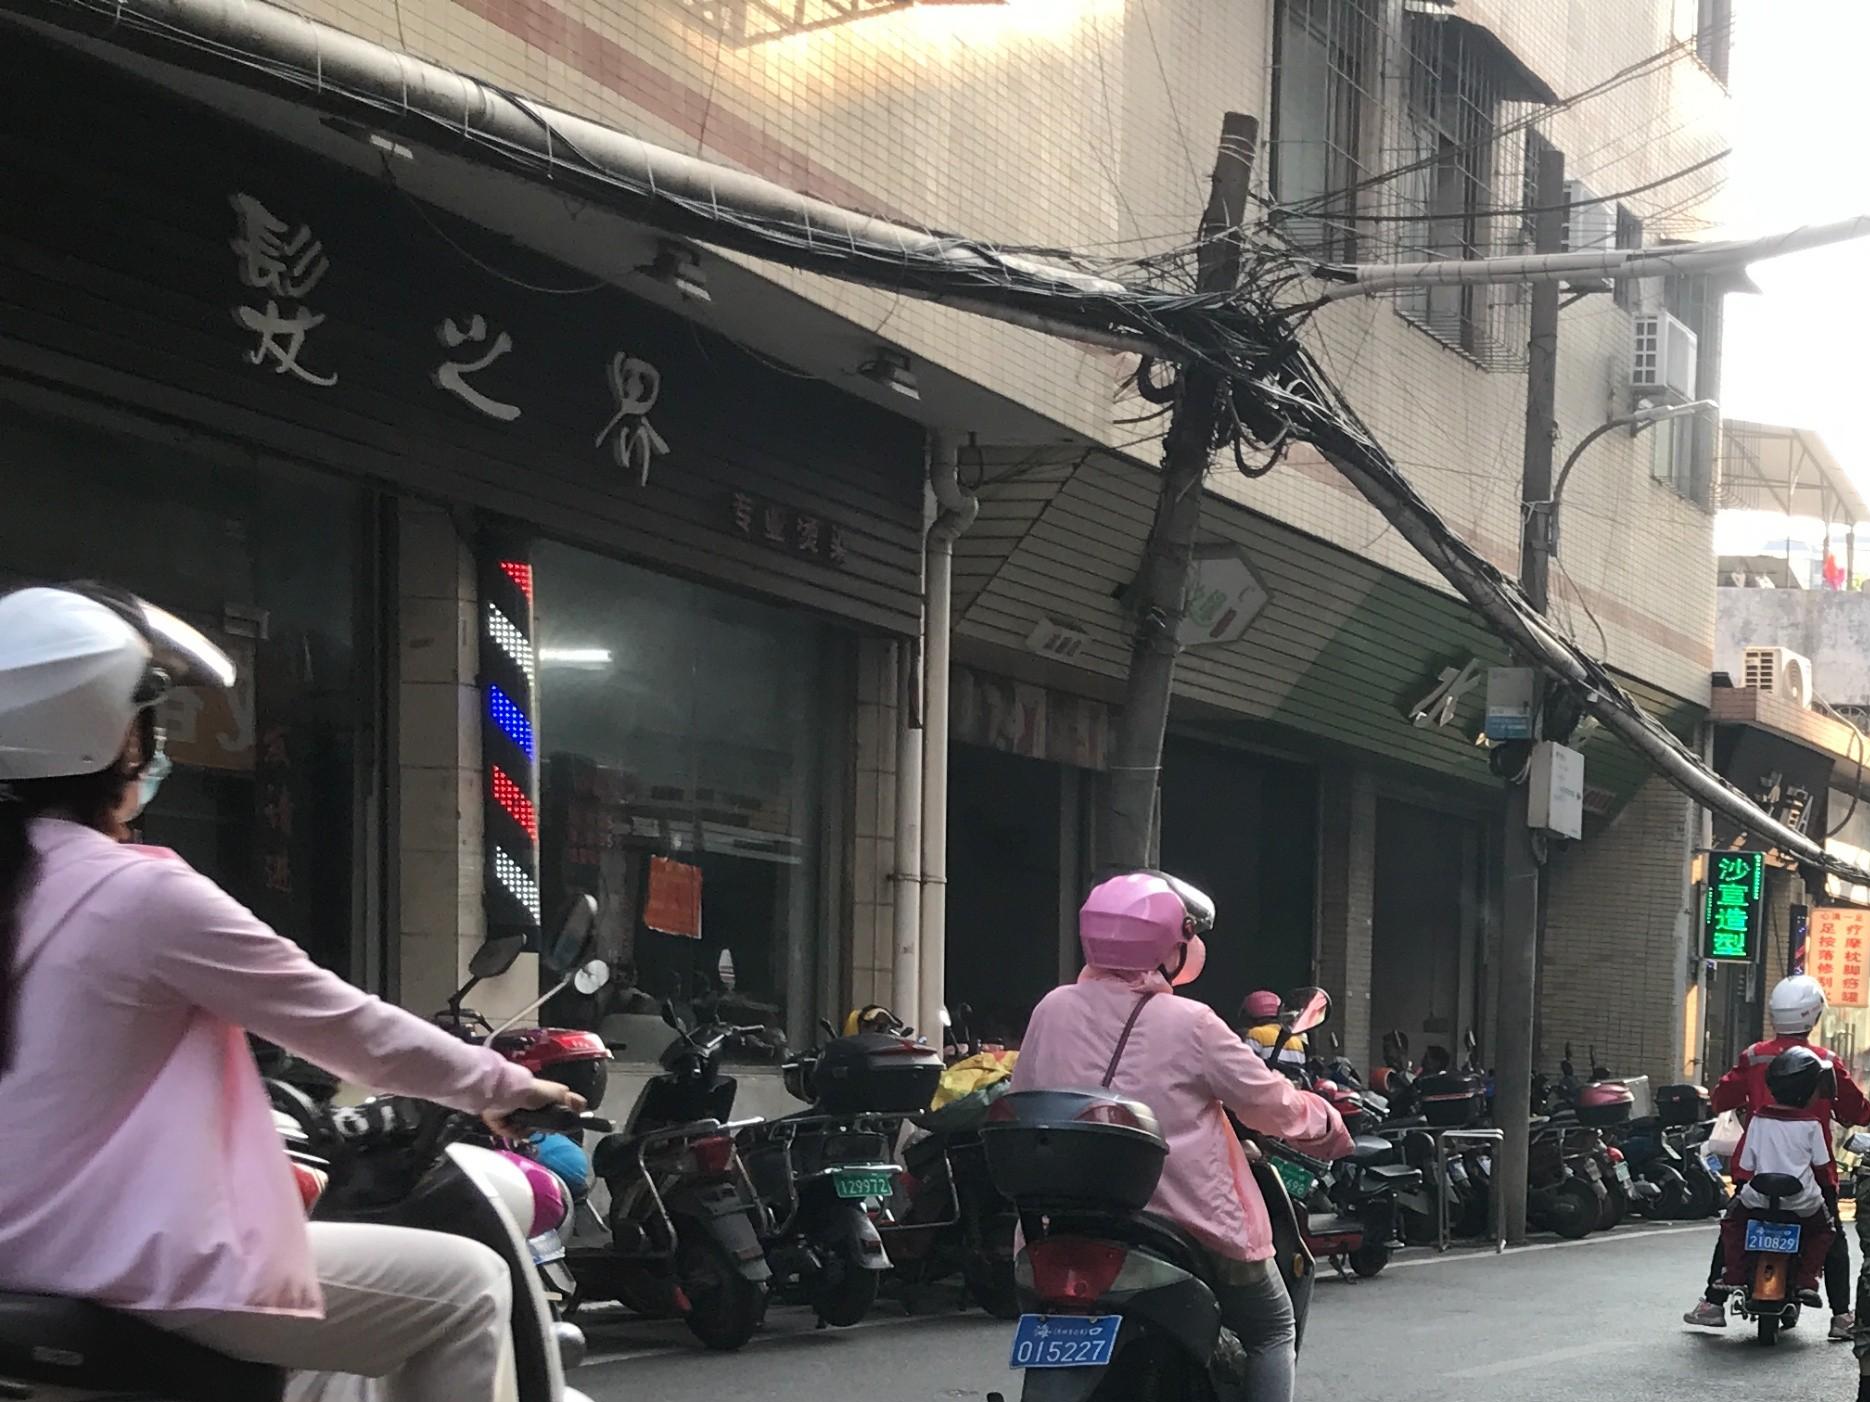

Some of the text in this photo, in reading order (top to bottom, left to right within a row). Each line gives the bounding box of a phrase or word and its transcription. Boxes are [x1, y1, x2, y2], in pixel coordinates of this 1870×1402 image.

[1712, 857, 1751, 956] 沙宣造型
[1748, 1235, 1796, 1250] 210829
[1017, 1340, 1106, 1363] 015227
